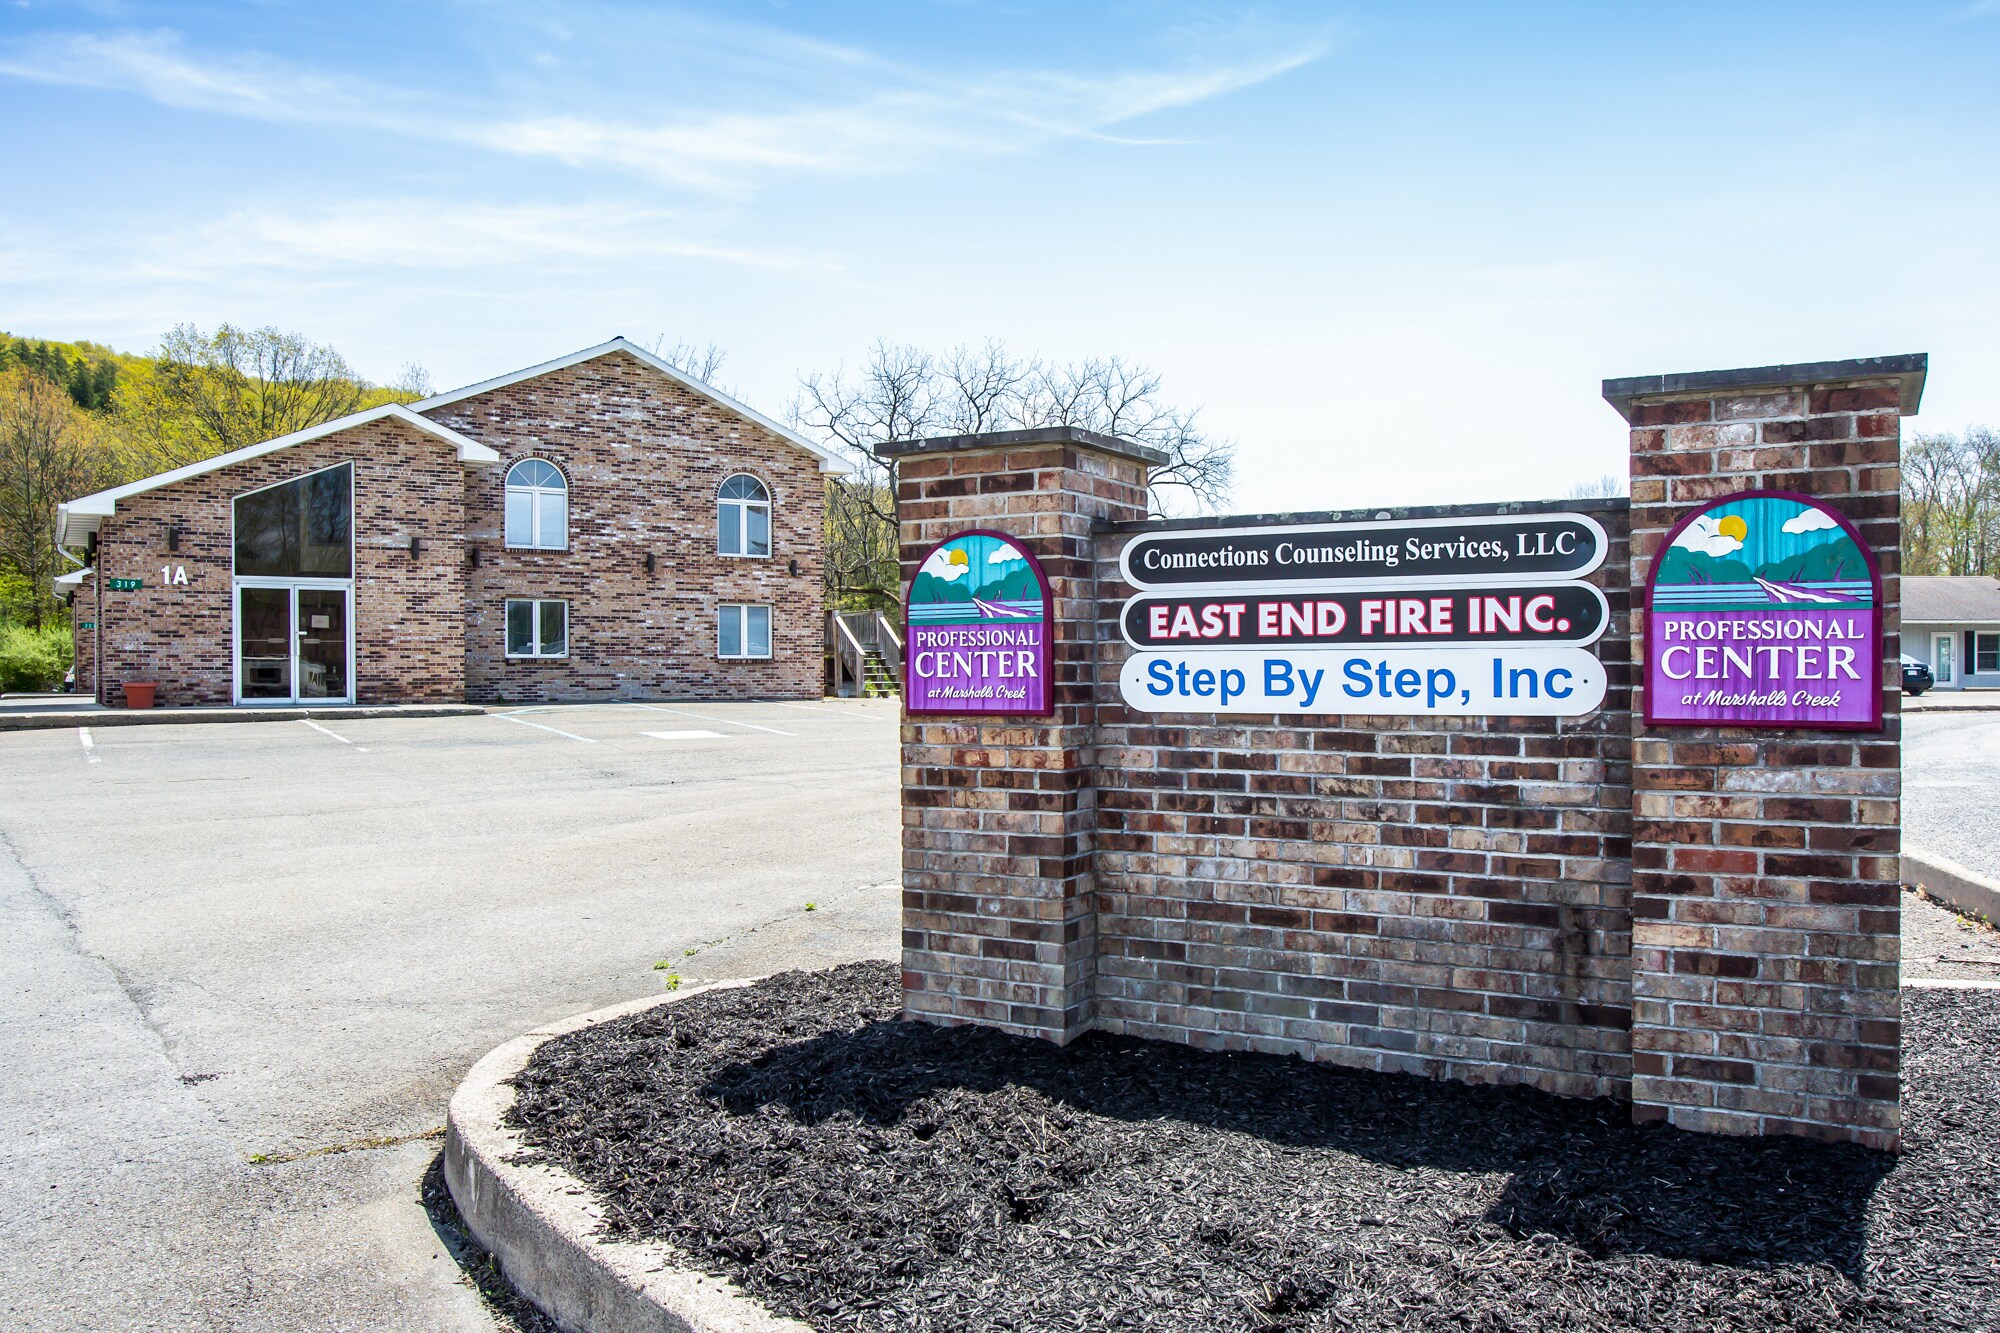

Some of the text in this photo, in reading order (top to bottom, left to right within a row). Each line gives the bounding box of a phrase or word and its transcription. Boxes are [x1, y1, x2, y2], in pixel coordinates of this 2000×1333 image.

[1143, 531, 1576, 571] Connections Counseling Services, LLC
[116, 580, 136, 588] 319
[160, 565, 189, 585] 1A
[1148, 595, 1572, 639] EAST END FIRE INC.
[916, 629, 1040, 647] PROFESSIONAL
[1664, 618, 1865, 641] PROFESSIONAL
[915, 650, 1038, 678] CENTER
[1660, 645, 1862, 680] CENTER
[927, 685, 1027, 699] at Marshalls Creek
[1146, 658, 1574, 709] Step By Step, Inc
[1681, 689, 1842, 708] at Marshalls Creek
